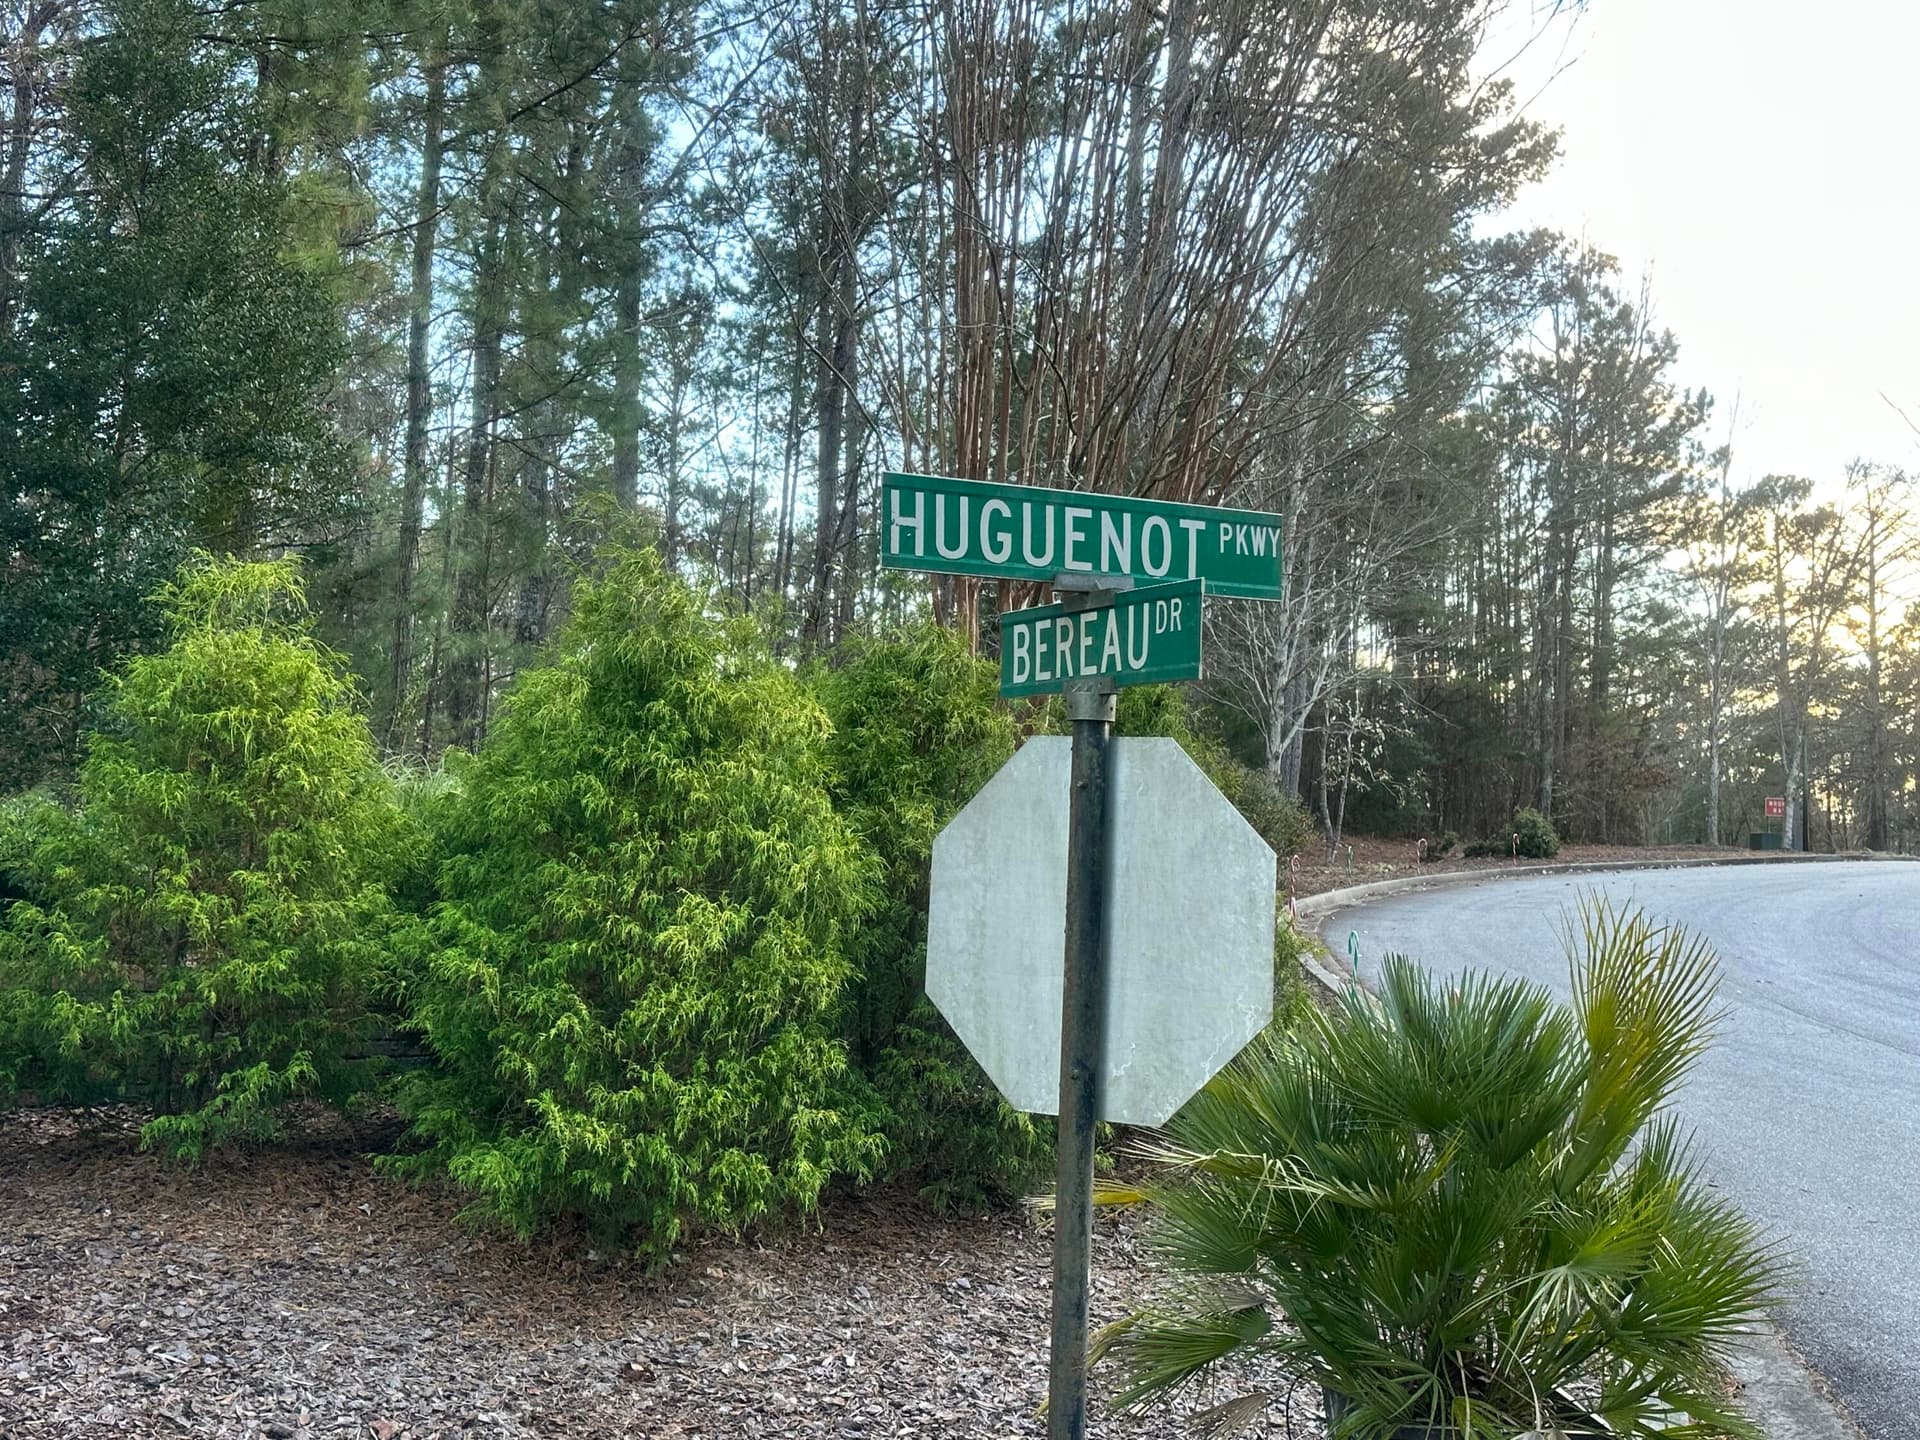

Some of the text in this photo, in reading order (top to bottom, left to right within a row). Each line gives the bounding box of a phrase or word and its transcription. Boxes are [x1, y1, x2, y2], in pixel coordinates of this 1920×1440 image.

[890, 489, 1281, 579] HUGUENOT PKWY
[1013, 597, 1182, 684] BEREAU DR
